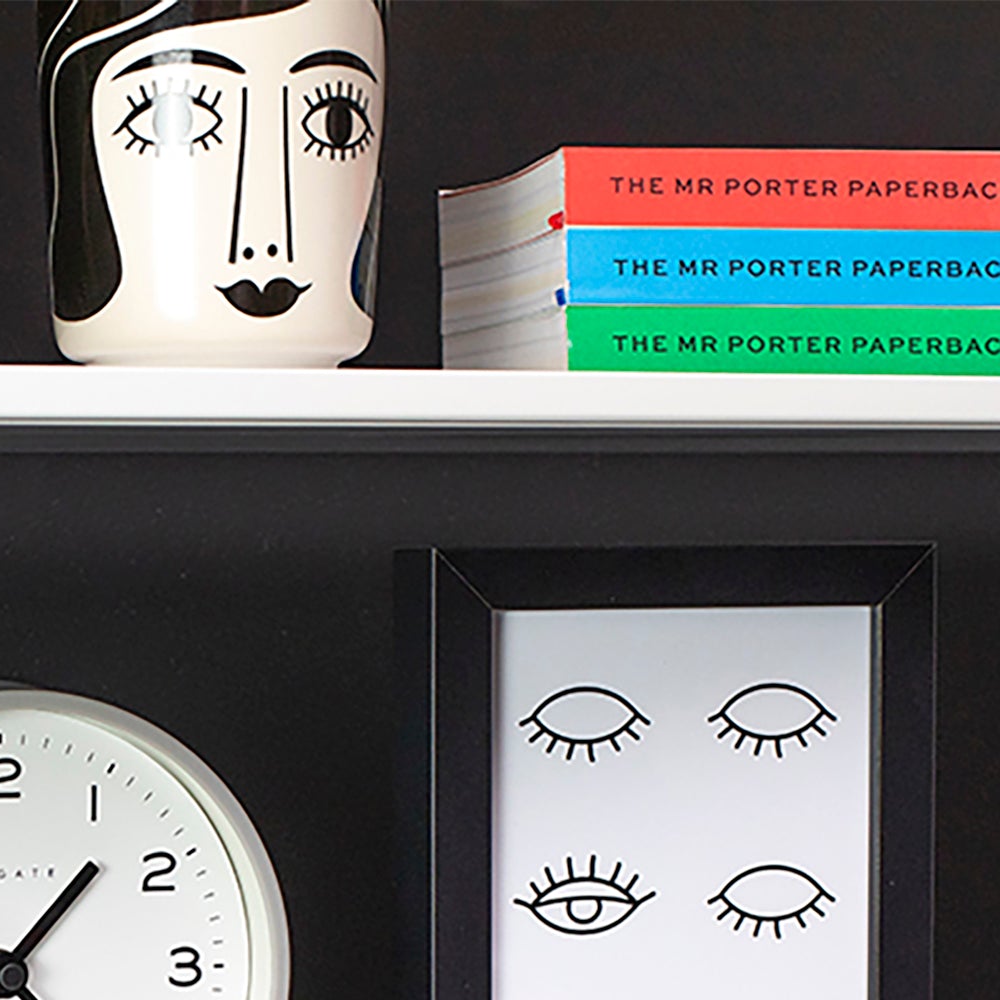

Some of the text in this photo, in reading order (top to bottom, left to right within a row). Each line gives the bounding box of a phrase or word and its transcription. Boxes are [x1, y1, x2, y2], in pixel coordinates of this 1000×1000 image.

[609, 176, 998, 200] THE MR PORTER PAPERBAC
[613, 258, 1000, 279] THE MR PORTER PAPERBAC
[612, 334, 1000, 356] THE MR PORTER PAPERBAC
[90, 784, 98, 822] 1
[140, 850, 177, 893] 2
[167, 945, 203, 989] 3
